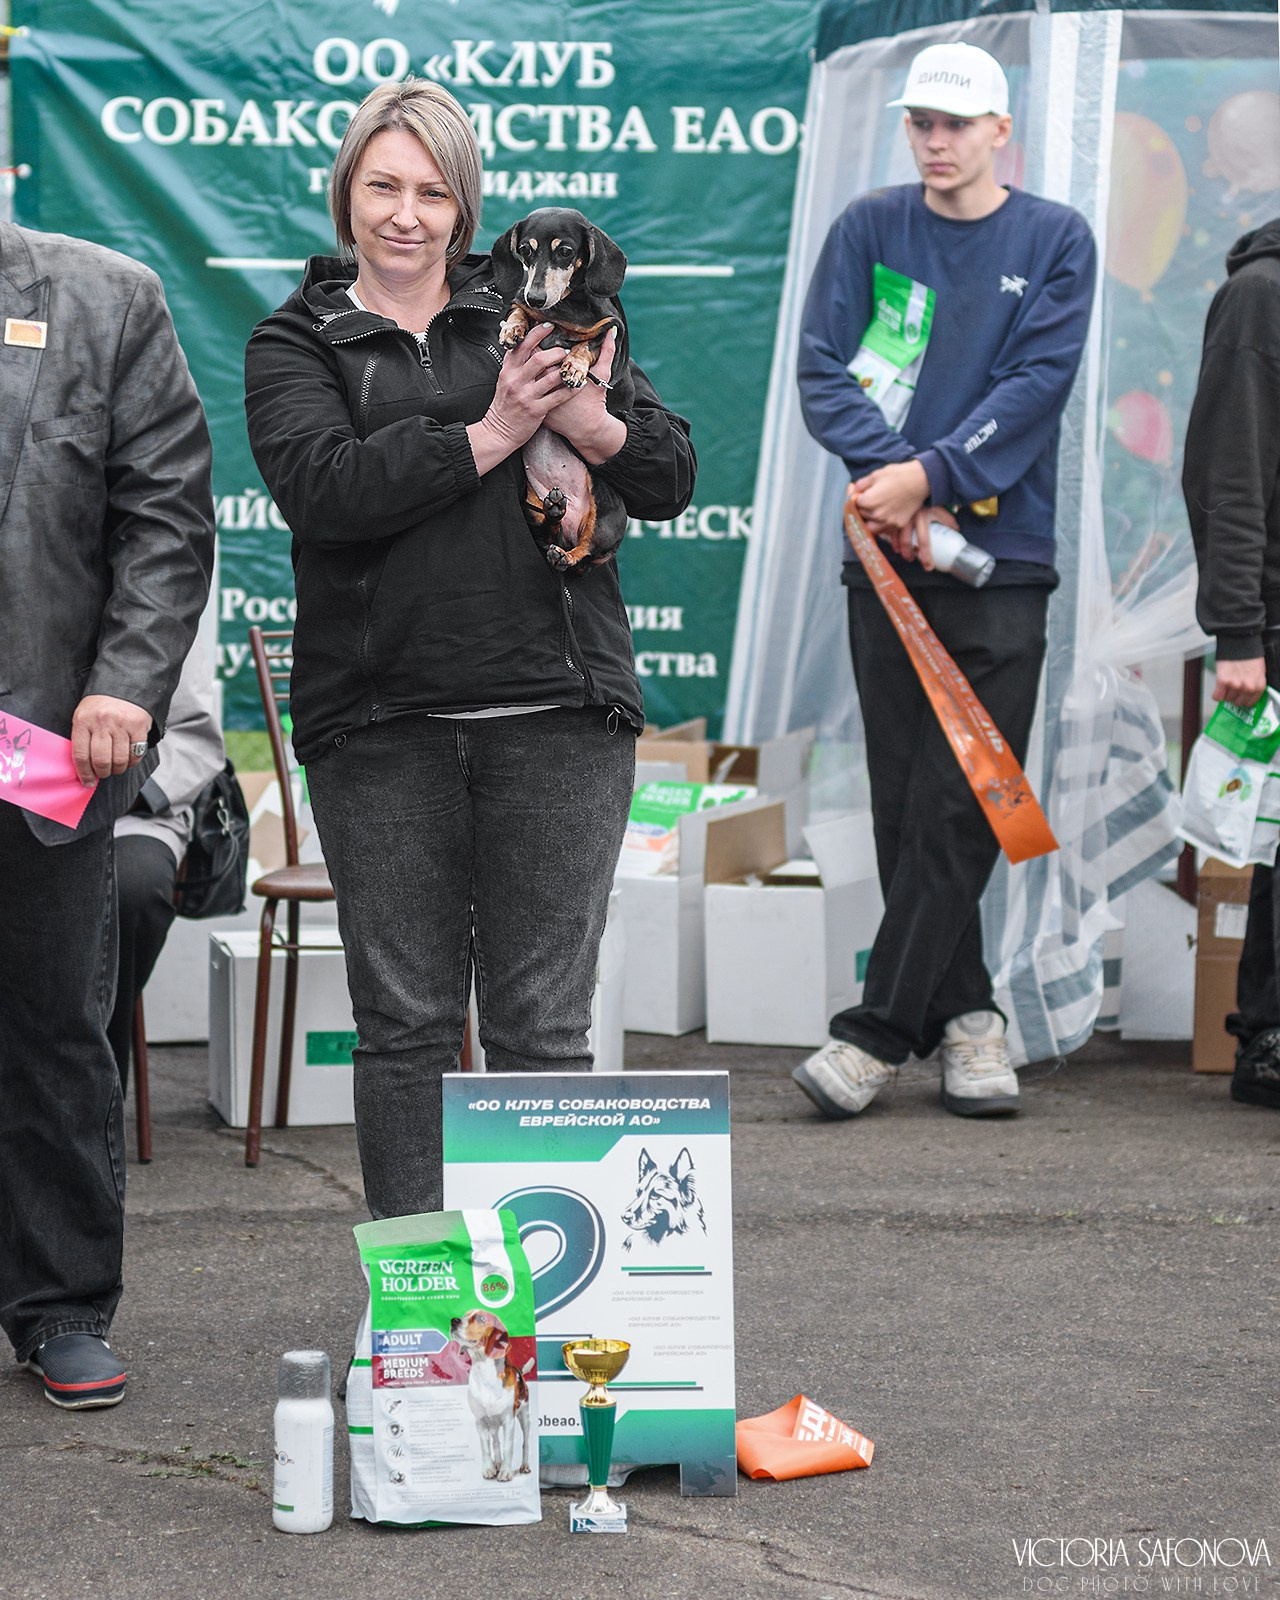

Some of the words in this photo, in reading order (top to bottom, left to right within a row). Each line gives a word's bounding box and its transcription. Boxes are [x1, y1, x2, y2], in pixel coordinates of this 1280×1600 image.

[312, 37, 409, 85] ОО
[422, 38, 617, 88] «КЛУБ
[468, 1100, 500, 1111] «ОО
[505, 1099, 554, 1111] КЛУБ
[558, 1098, 711, 1112] СОБАКОВОДСТВА
[519, 1113, 624, 1127] ЕВРЕЙСКОЙ
[629, 1115, 661, 1127] АО»
[390, 1259, 454, 1275] GREEN
[381, 1276, 460, 1292] HOLDER
[483, 1281, 507, 1292] 86%
[383, 1334, 422, 1346] ADULT
[383, 1357, 429, 1369] MEDIUM
[383, 1368, 425, 1379] BREEDS
